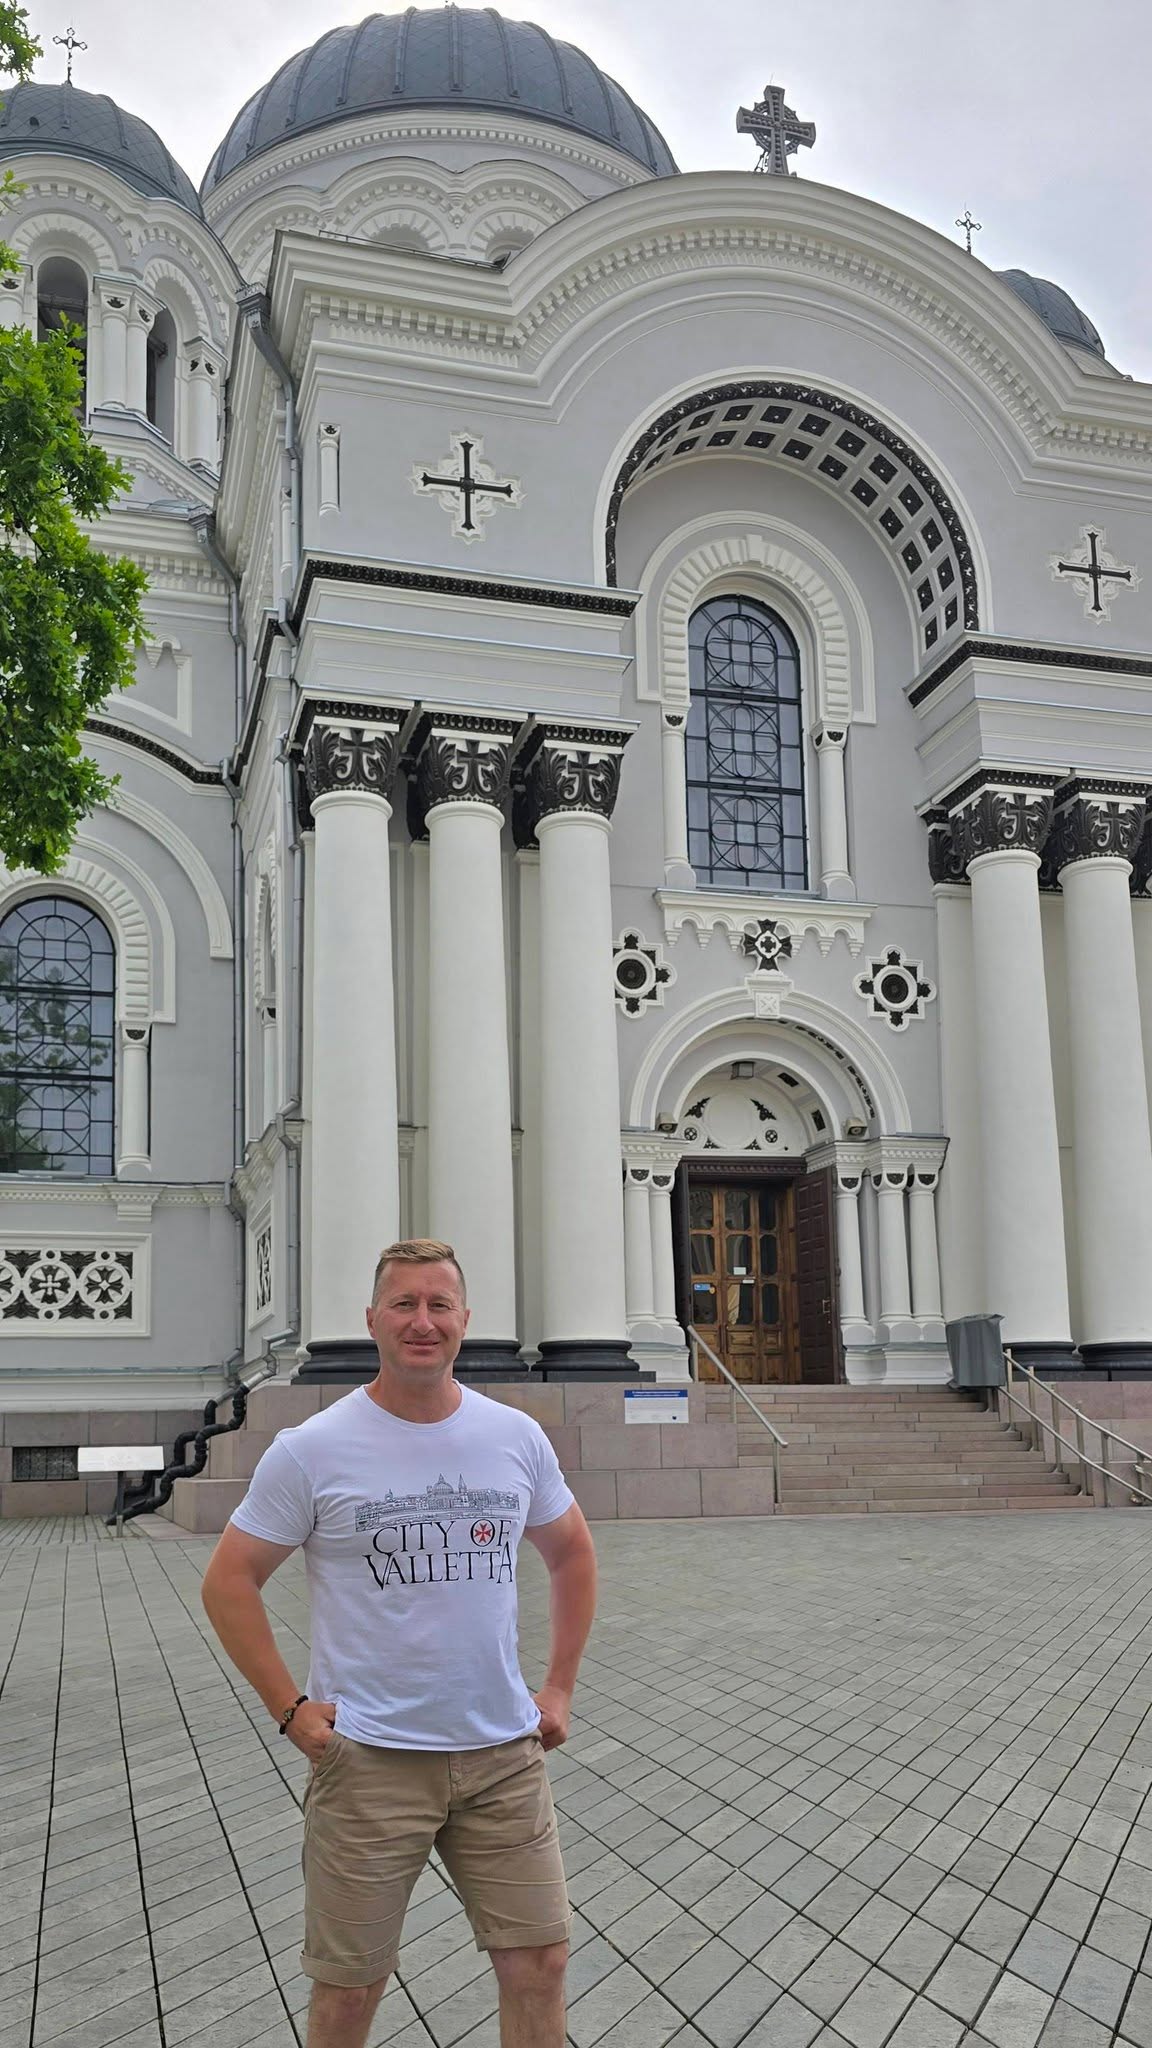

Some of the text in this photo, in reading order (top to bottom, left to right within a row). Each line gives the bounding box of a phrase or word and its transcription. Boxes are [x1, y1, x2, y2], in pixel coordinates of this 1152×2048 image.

[372, 1519, 512, 1555] CITY OF
[362, 1541, 513, 1590] VALLETTA
